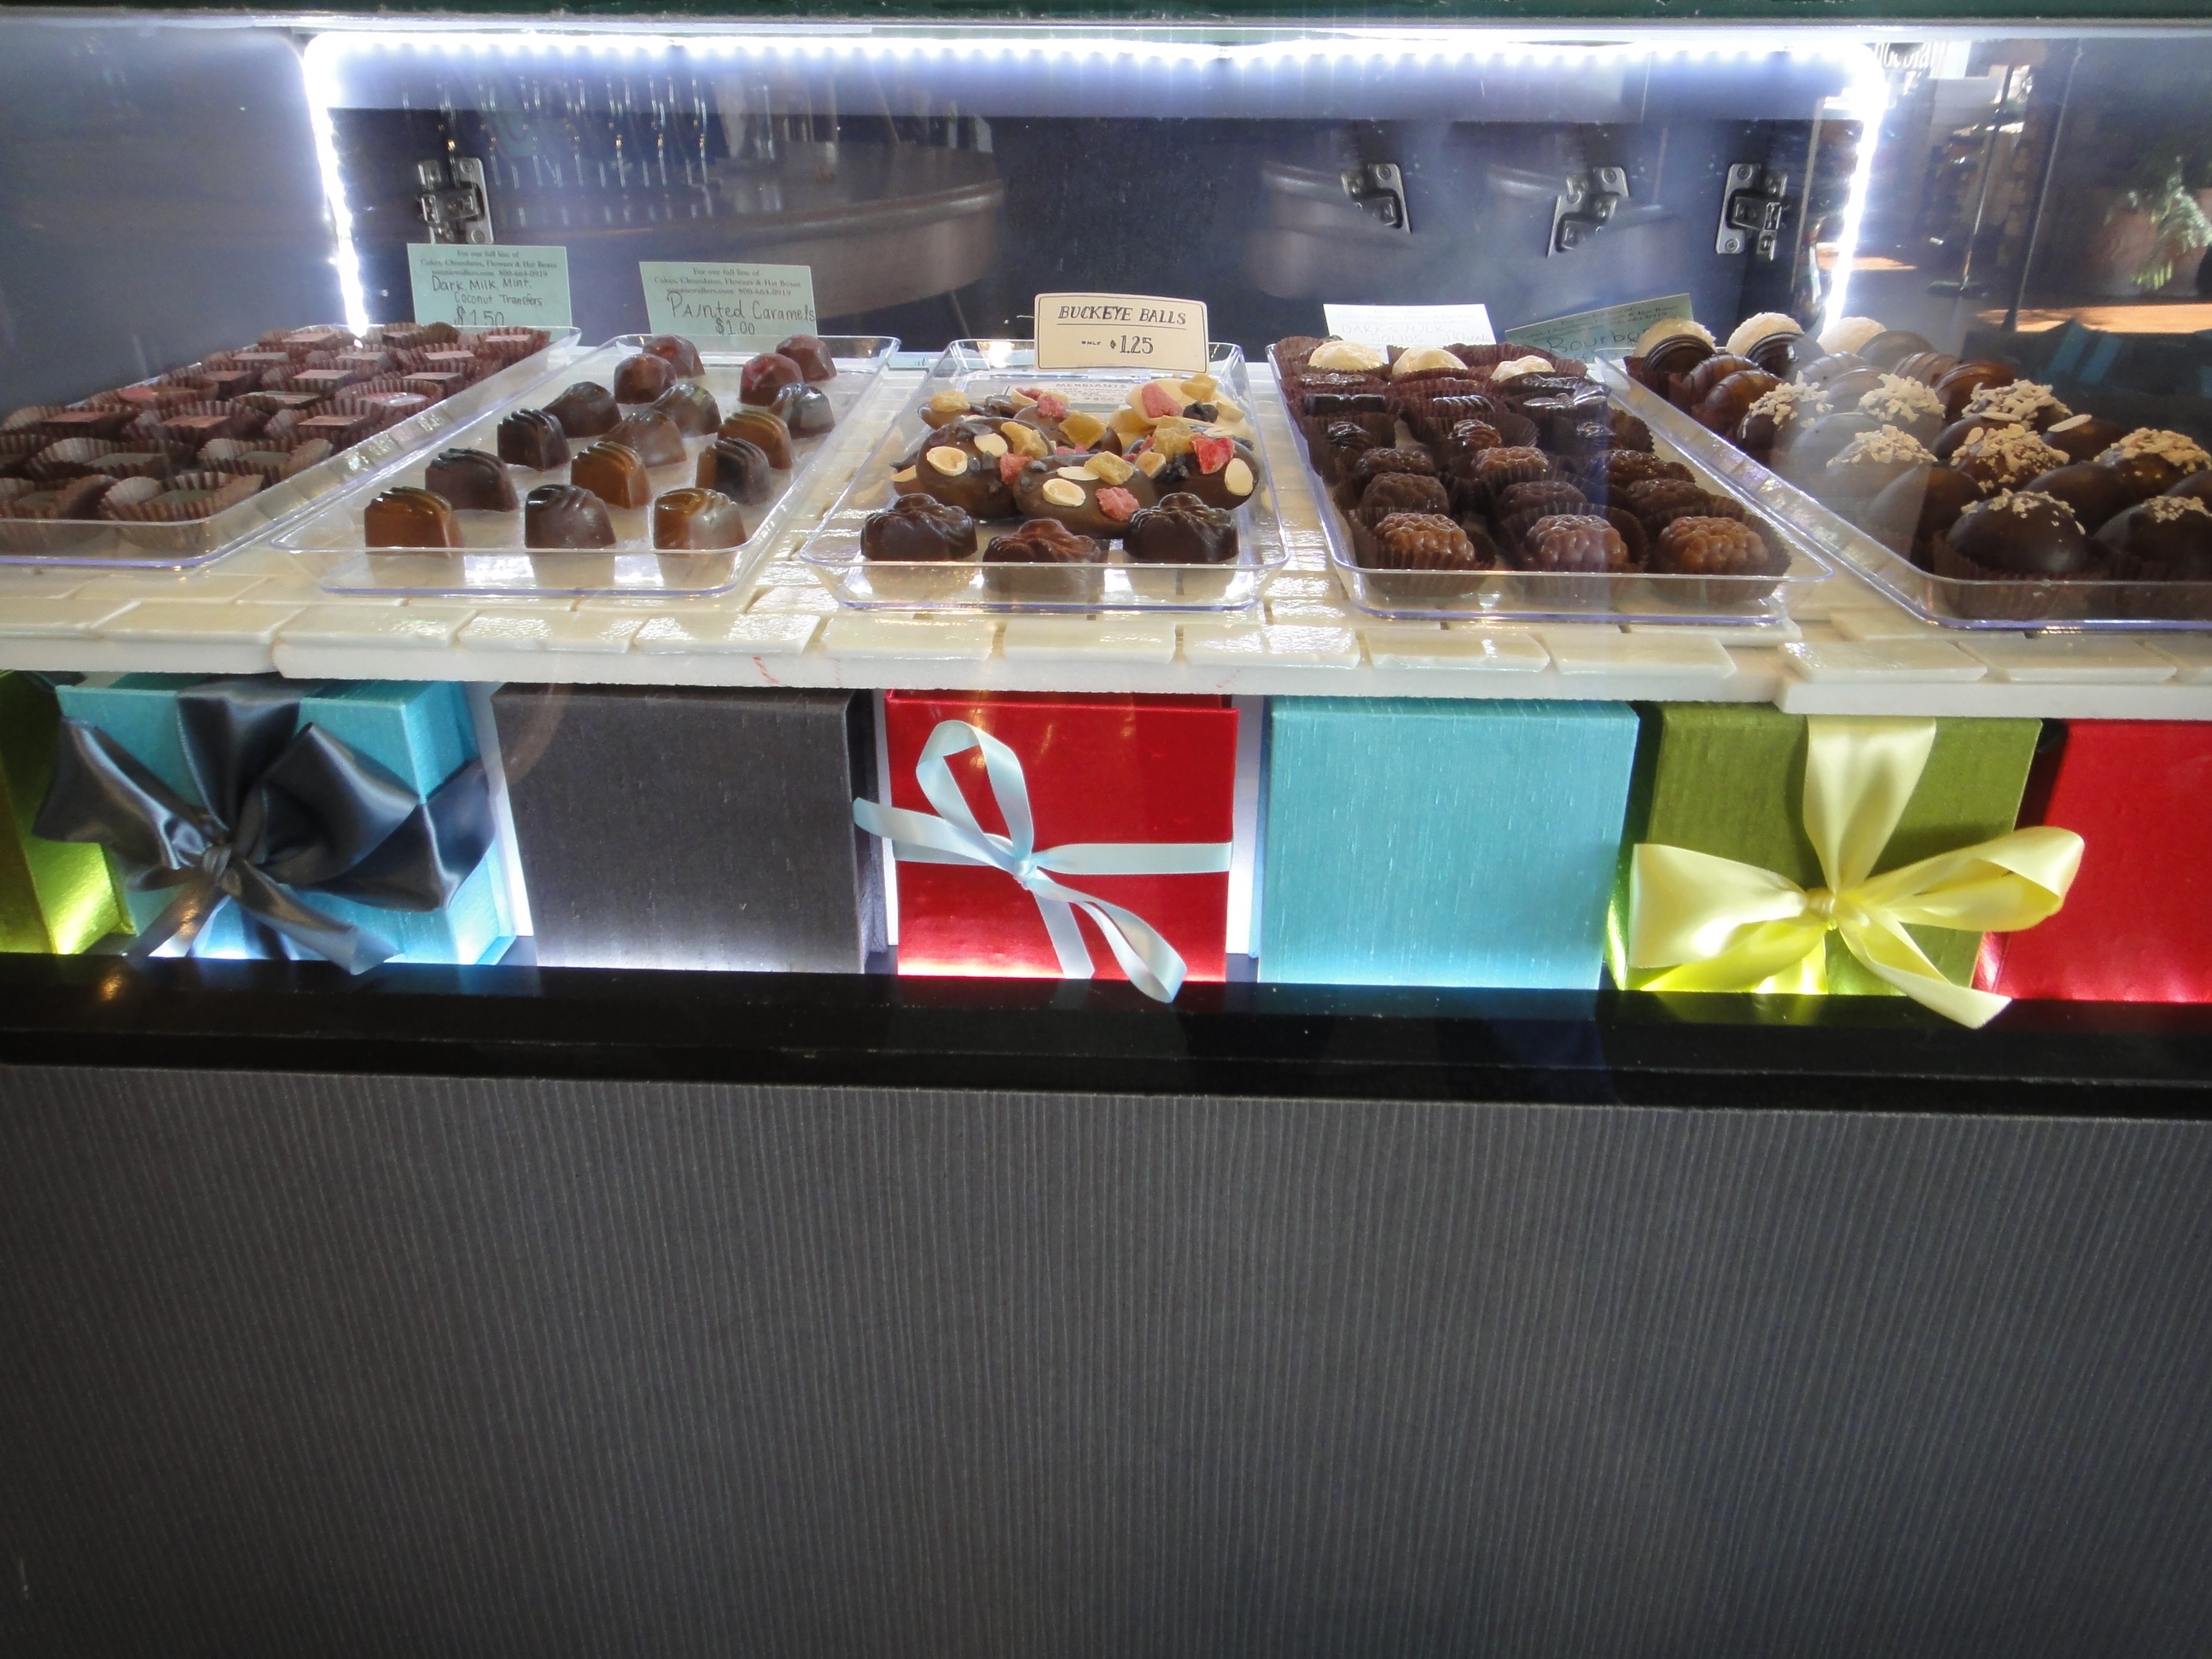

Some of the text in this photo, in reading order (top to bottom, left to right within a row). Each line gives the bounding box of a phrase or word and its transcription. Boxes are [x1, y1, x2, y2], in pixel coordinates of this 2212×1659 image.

[454, 291, 544, 306] Coconut Transfers
[752, 300, 816, 323] Caramels
[1057, 305, 1187, 325] BUCKEYE BALLS
[715, 316, 755, 335] $1.00
[1109, 335, 1154, 355] $1.25
[1546, 328, 1651, 352] Bourbo
